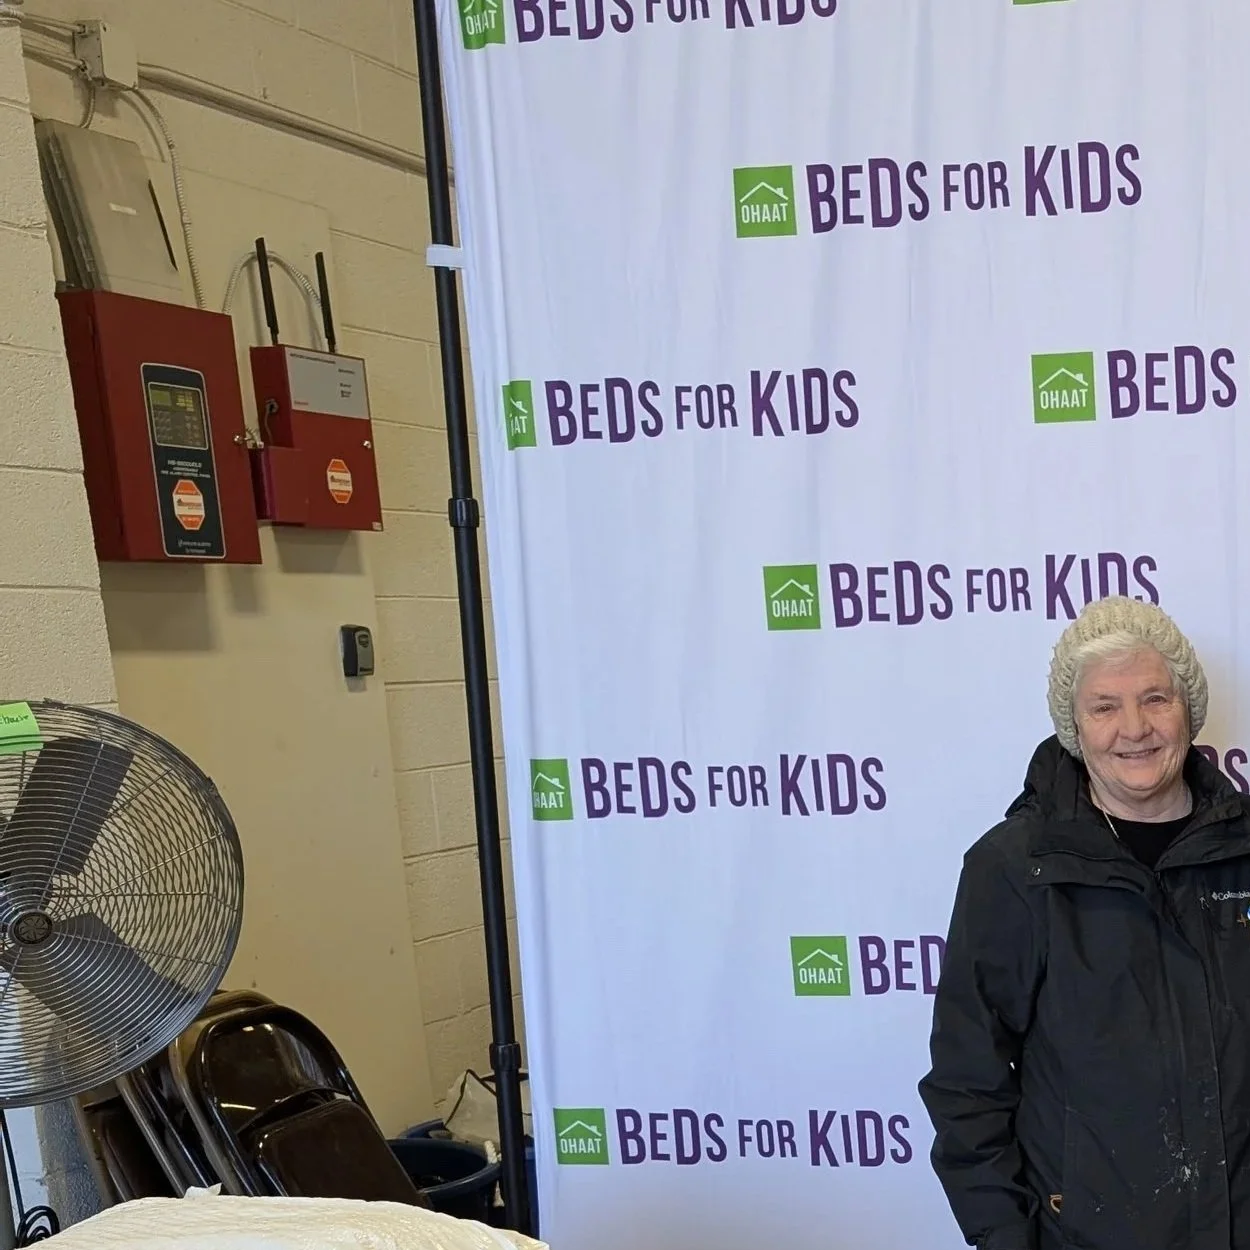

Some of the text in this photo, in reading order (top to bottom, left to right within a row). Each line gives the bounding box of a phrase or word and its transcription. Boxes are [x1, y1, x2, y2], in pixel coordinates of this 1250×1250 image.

[742, 203, 787, 223] OHAAT
[807, 142, 1141, 233] BEDS FOR KIDS
[545, 368, 858, 445] BEDS FOR KIDS
[1041, 389, 1087, 409] OHAAT
[1107, 346, 1236, 418] BEDS
[773, 599, 812, 617] OHAAT
[830, 552, 1159, 627] BEDS FOR KIDS
[581, 754, 886, 818] BEDS FOR KIDS
[800, 968, 841, 983] OHAAT
[858, 934, 947, 995] BED
[561, 1139, 600, 1153] OHAAT
[616, 1109, 912, 1167] BEDS FOR KIDS
